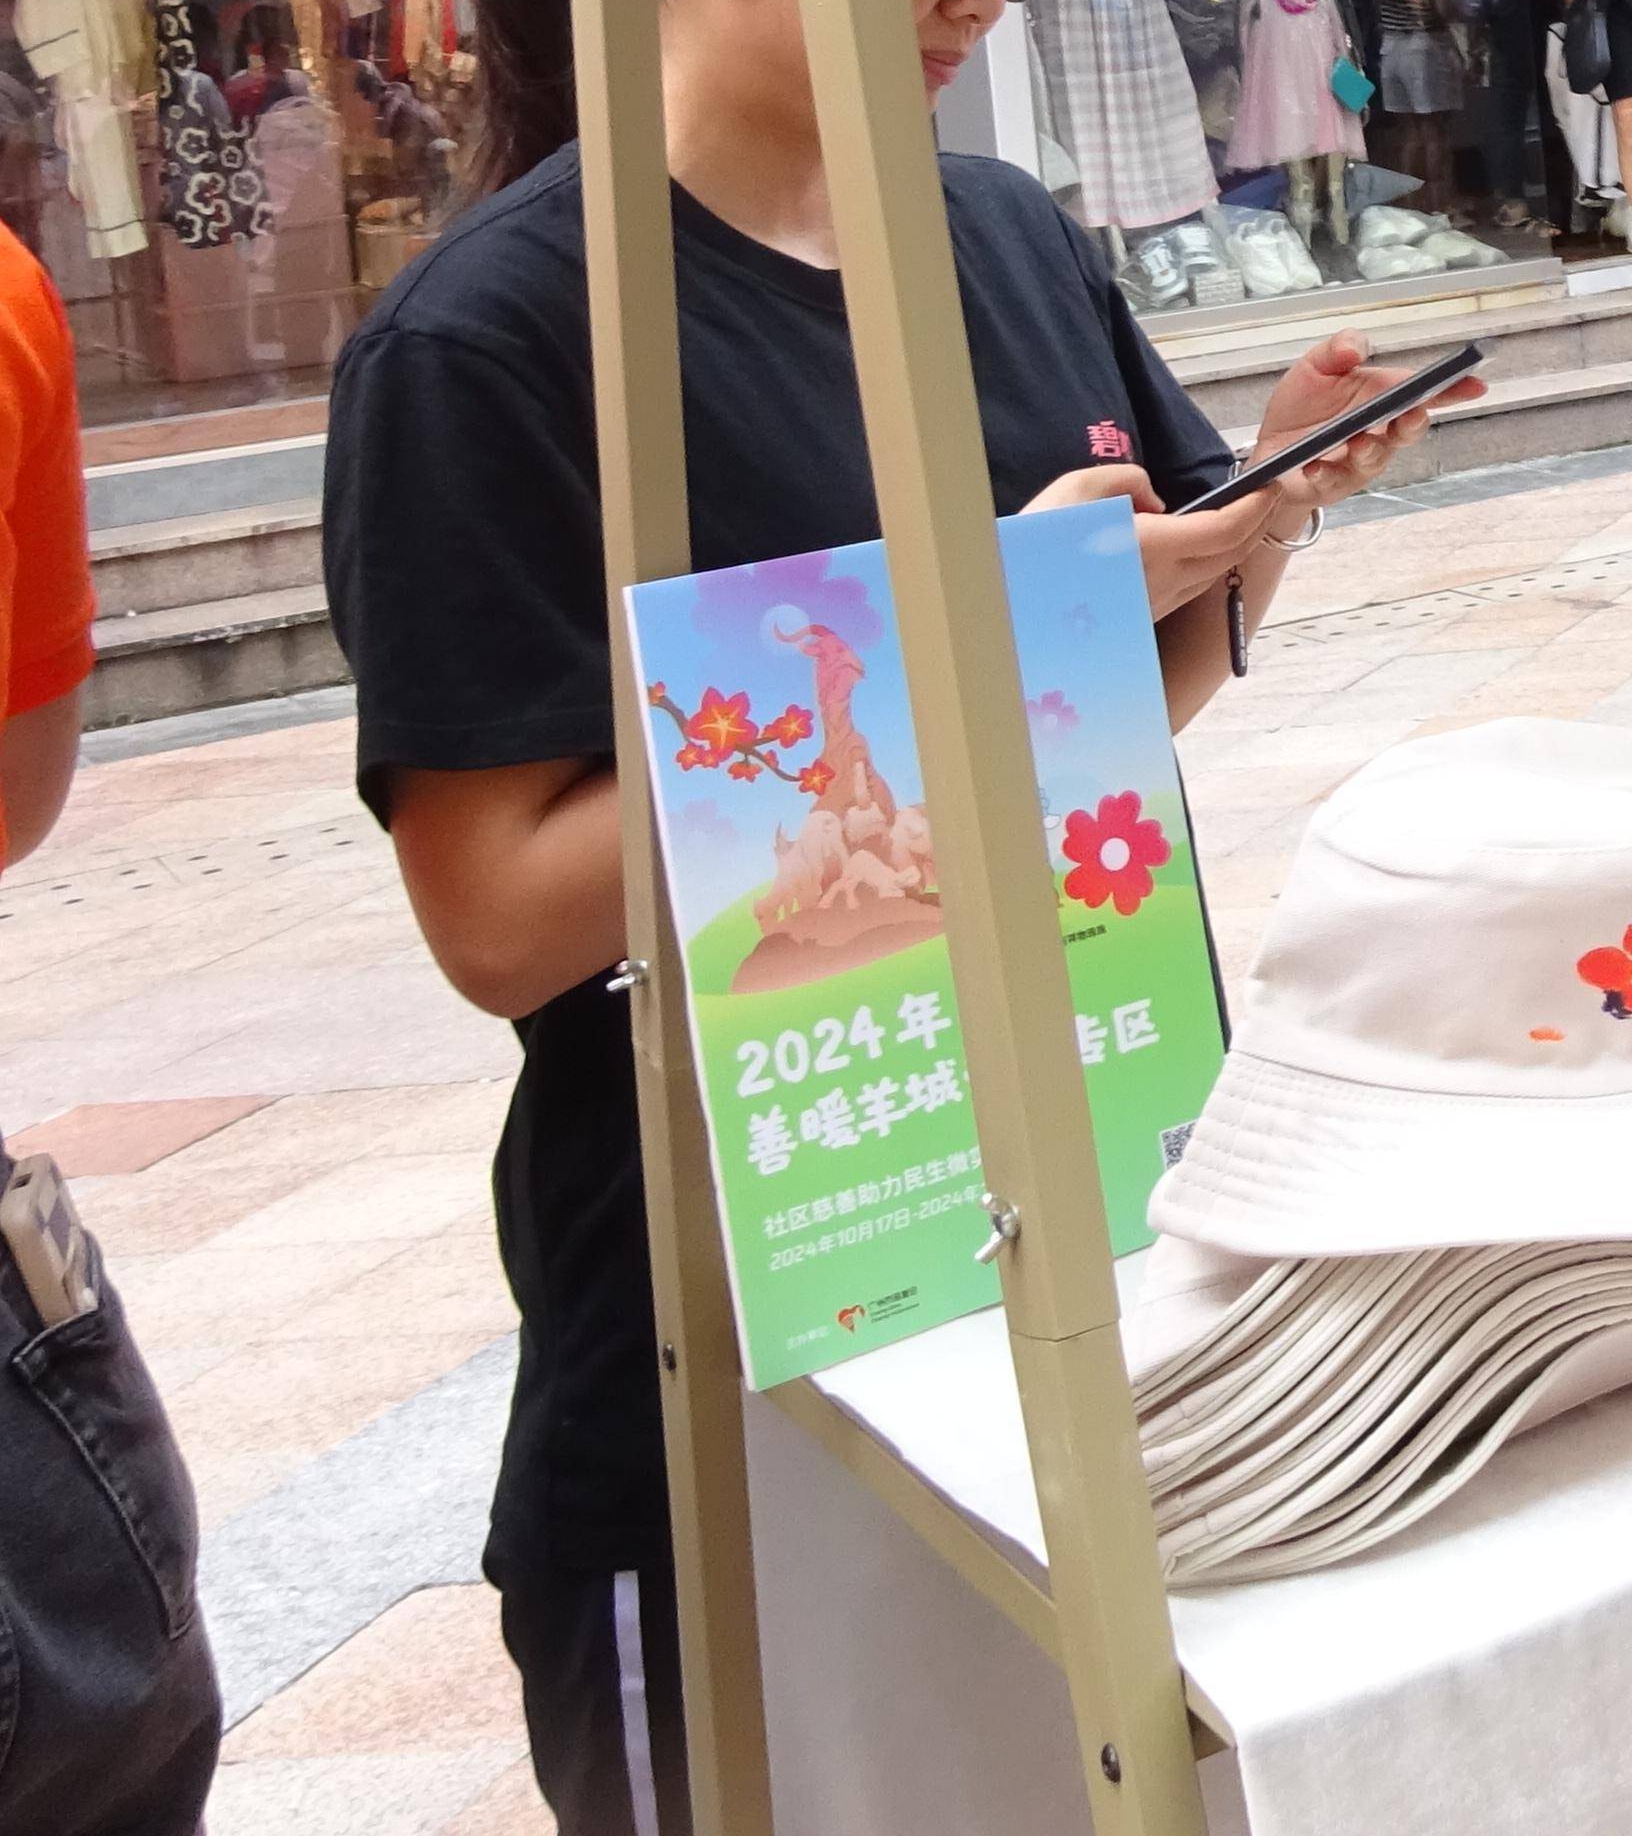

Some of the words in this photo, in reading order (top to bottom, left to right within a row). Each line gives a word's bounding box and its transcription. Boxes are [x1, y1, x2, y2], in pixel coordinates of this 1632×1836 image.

[734, 990, 952, 1097] 2024年
[768, 1182, 985, 1271] 2024年10月17日-2024年
